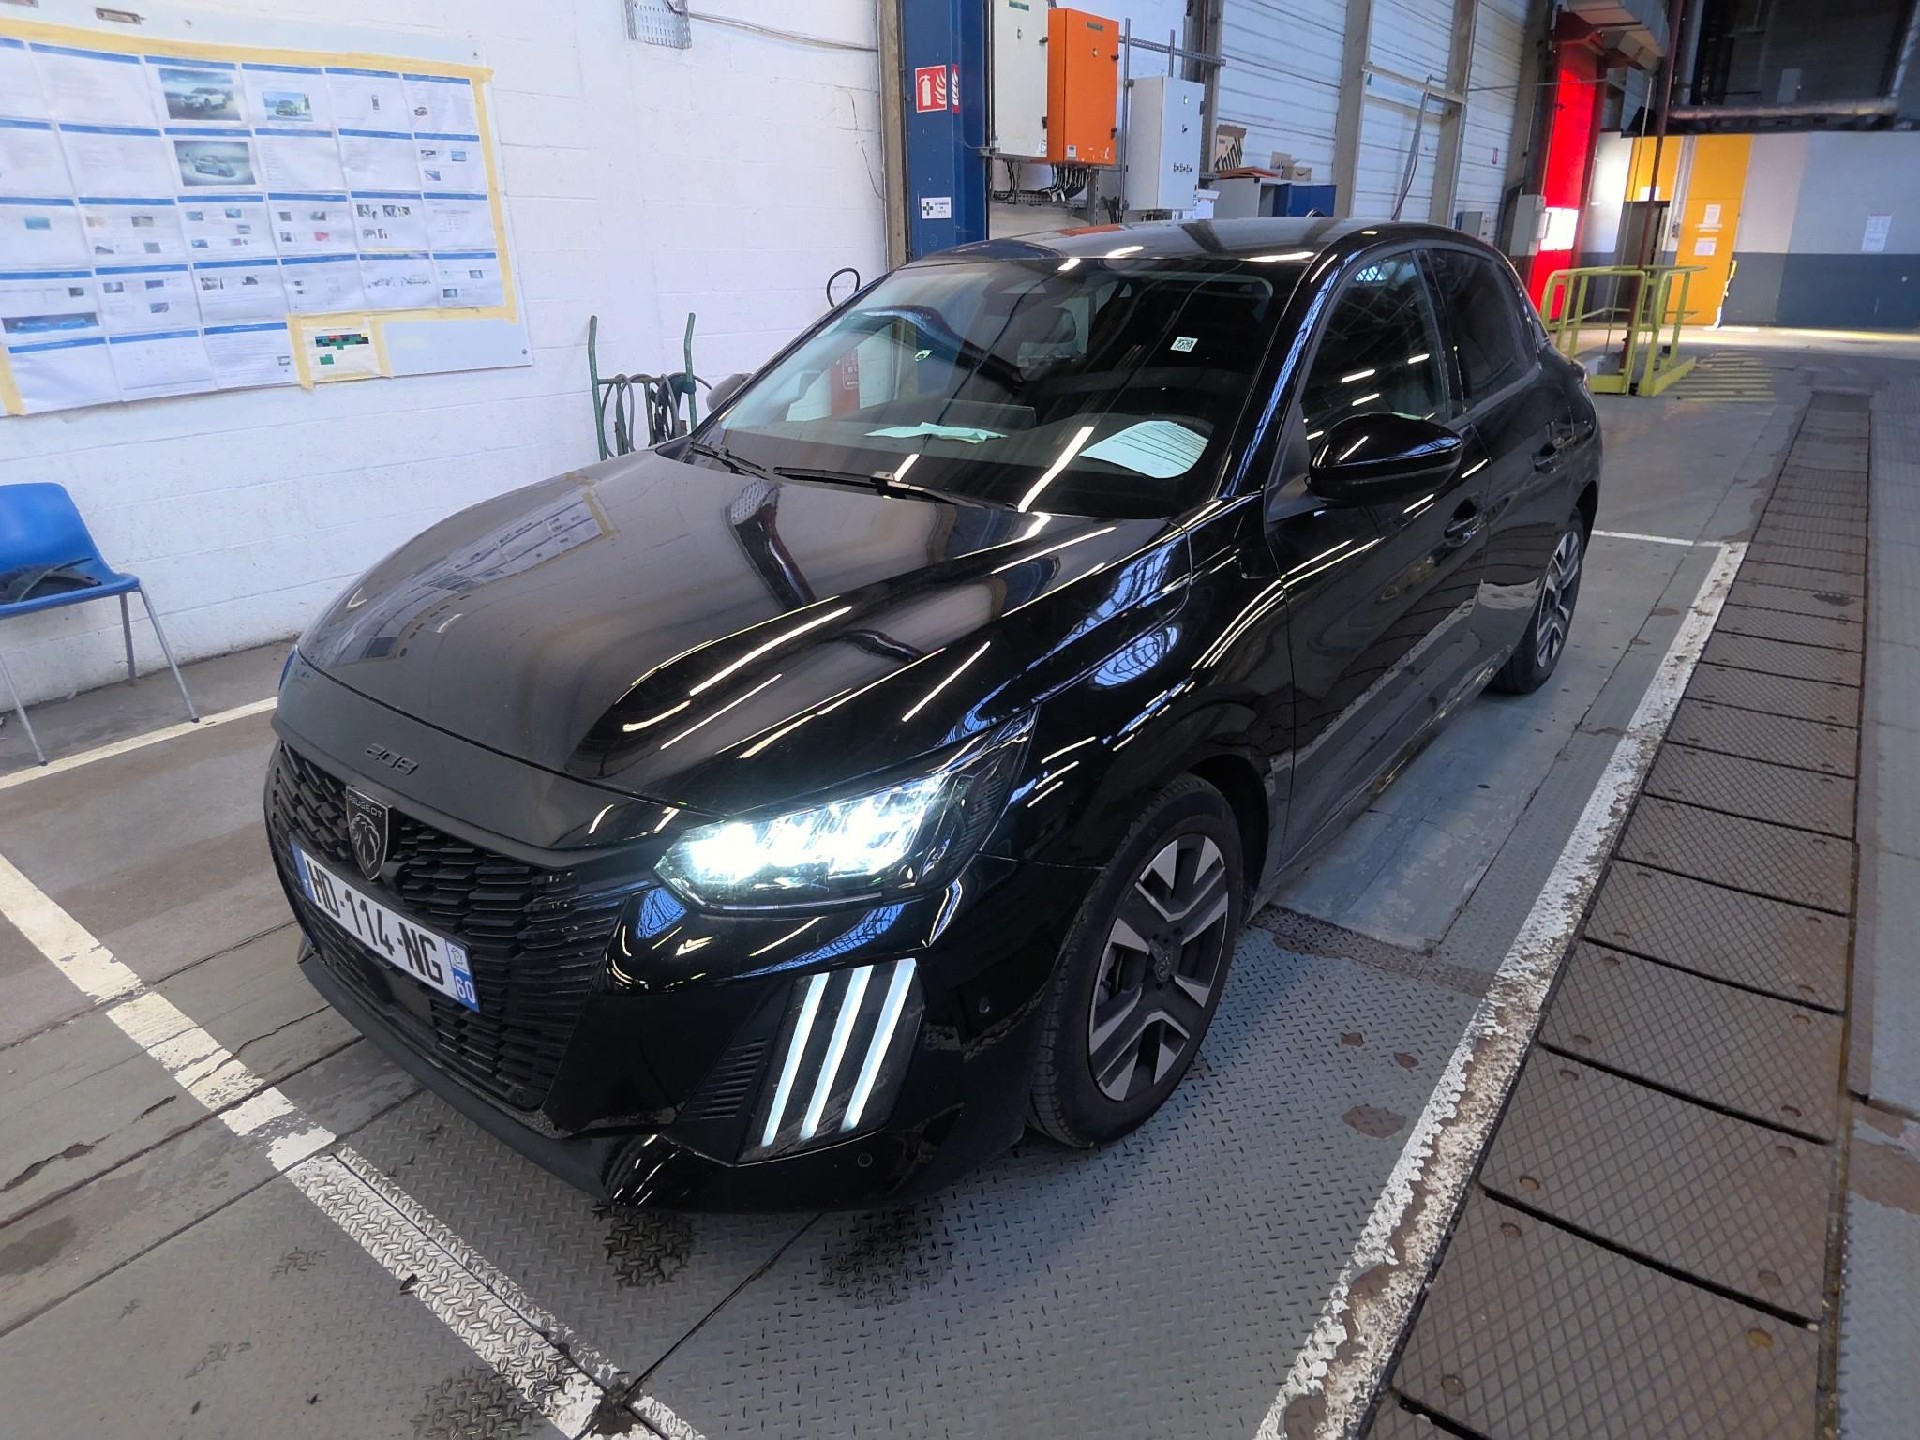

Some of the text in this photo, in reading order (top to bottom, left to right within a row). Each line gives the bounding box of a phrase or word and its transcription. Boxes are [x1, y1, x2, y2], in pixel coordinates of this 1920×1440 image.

[365, 743, 419, 775] 208
[347, 794, 383, 817] PEUGEOT
[306, 860, 444, 986] HD-114-NG
[455, 975, 477, 1004] 60
